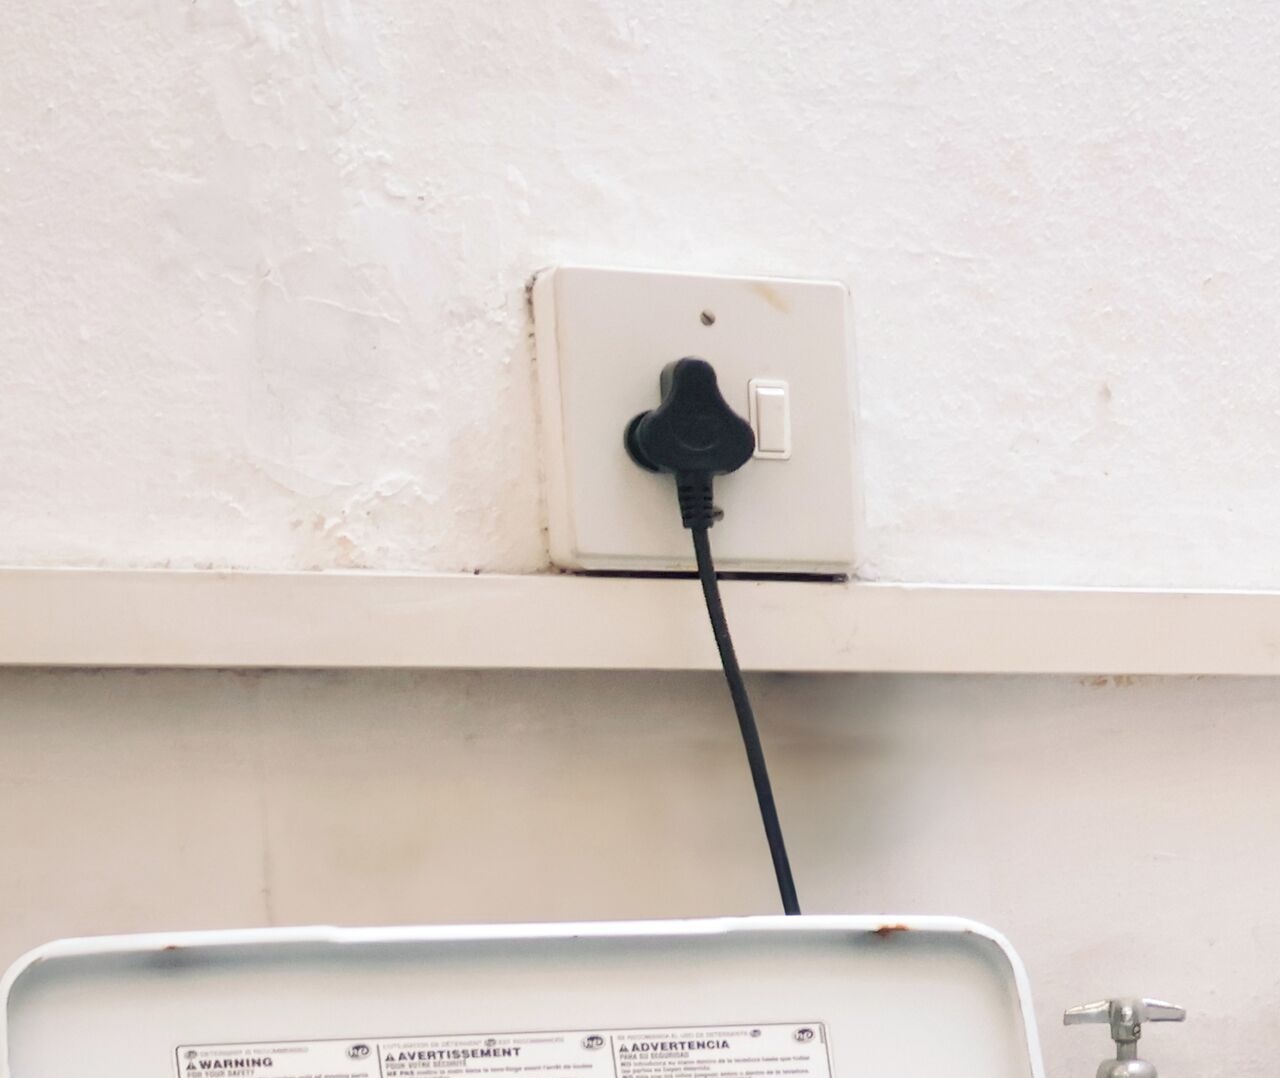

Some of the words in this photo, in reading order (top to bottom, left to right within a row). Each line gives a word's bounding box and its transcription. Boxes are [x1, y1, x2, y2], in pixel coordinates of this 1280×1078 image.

[631, 1040, 729, 1052] ADVERTENCIA
[398, 1047, 520, 1061] AVERTISSEMENT
[199, 1057, 273, 1069] WARNING
